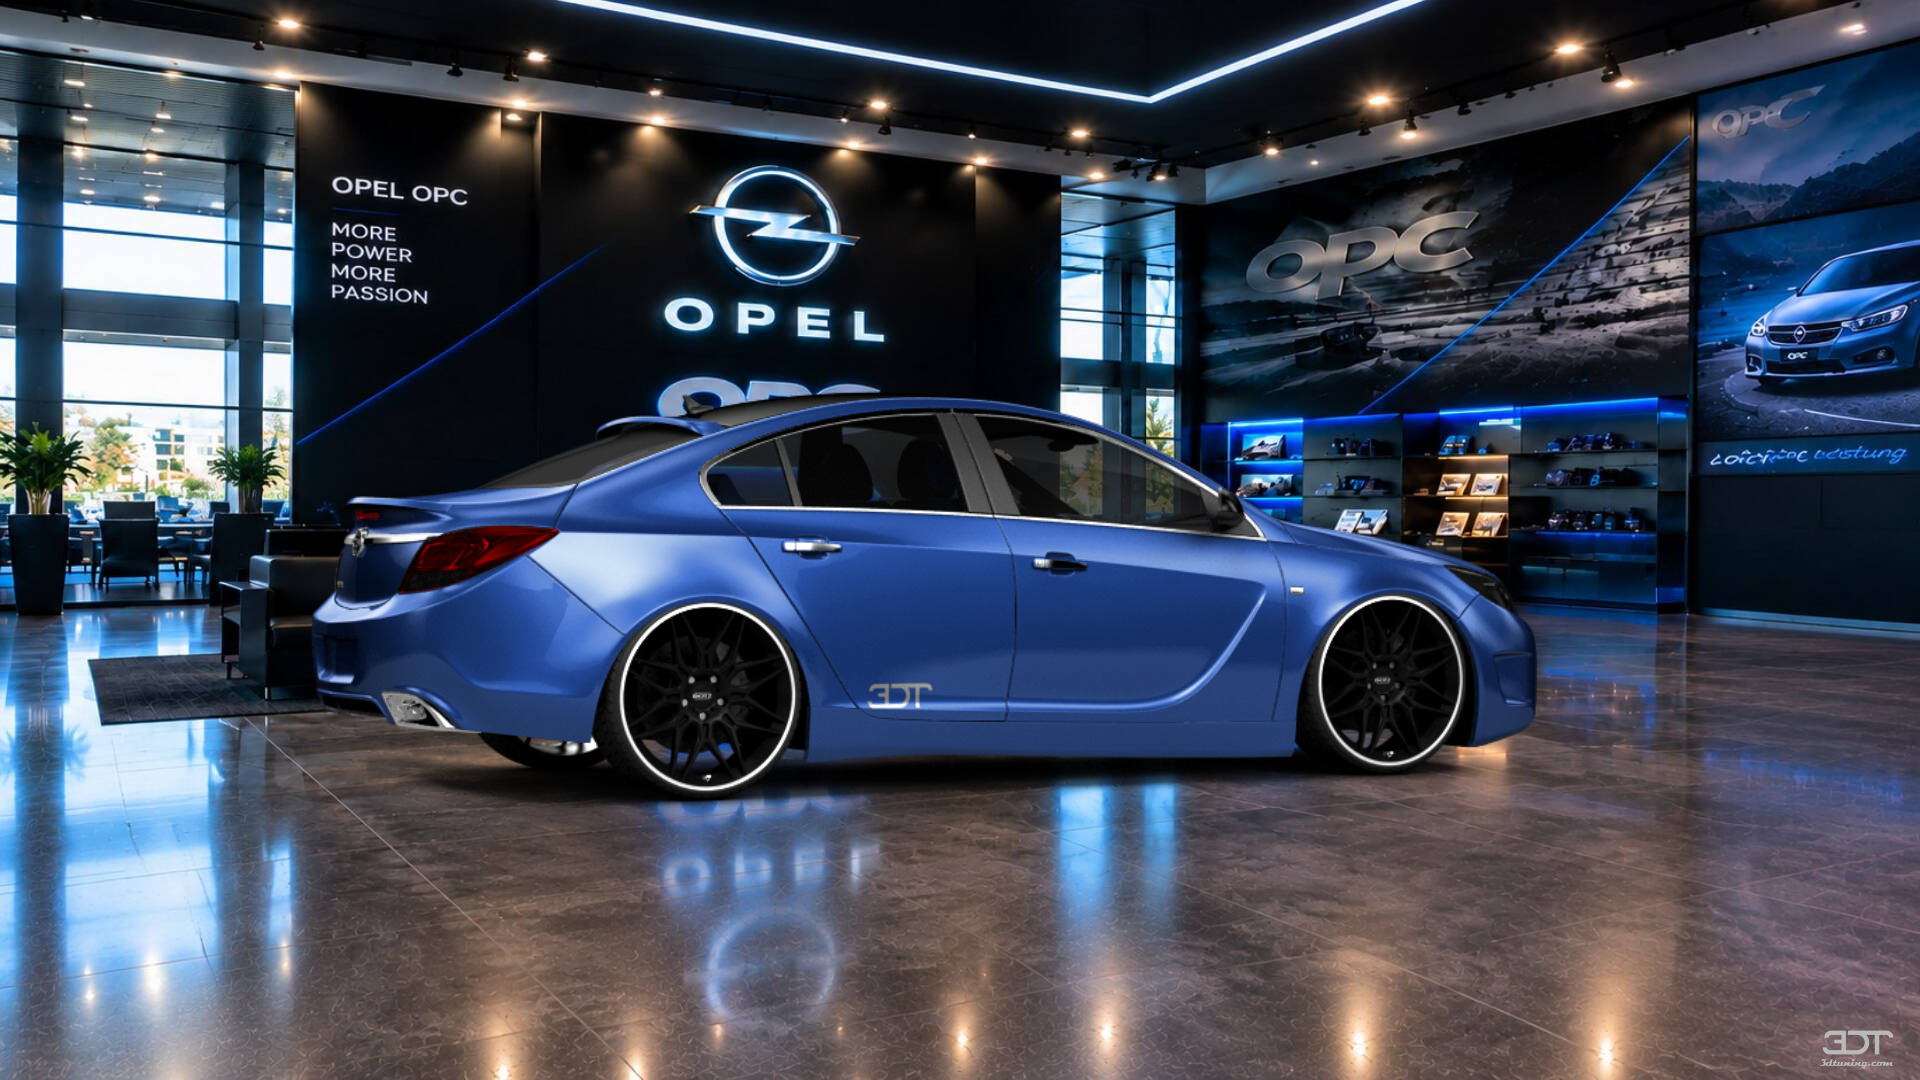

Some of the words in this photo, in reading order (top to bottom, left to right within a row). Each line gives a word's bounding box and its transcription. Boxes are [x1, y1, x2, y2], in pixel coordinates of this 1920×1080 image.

[331, 176, 404, 200] OPEL
[412, 185, 468, 206] OPC
[331, 222, 396, 242] MORE
[331, 242, 412, 263] POWER
[1246, 211, 1480, 300] OPC
[331, 263, 396, 283] MORE
[331, 284, 428, 305] PASSION
[664, 297, 885, 343] OPEL
[867, 682, 933, 709] 3DT
